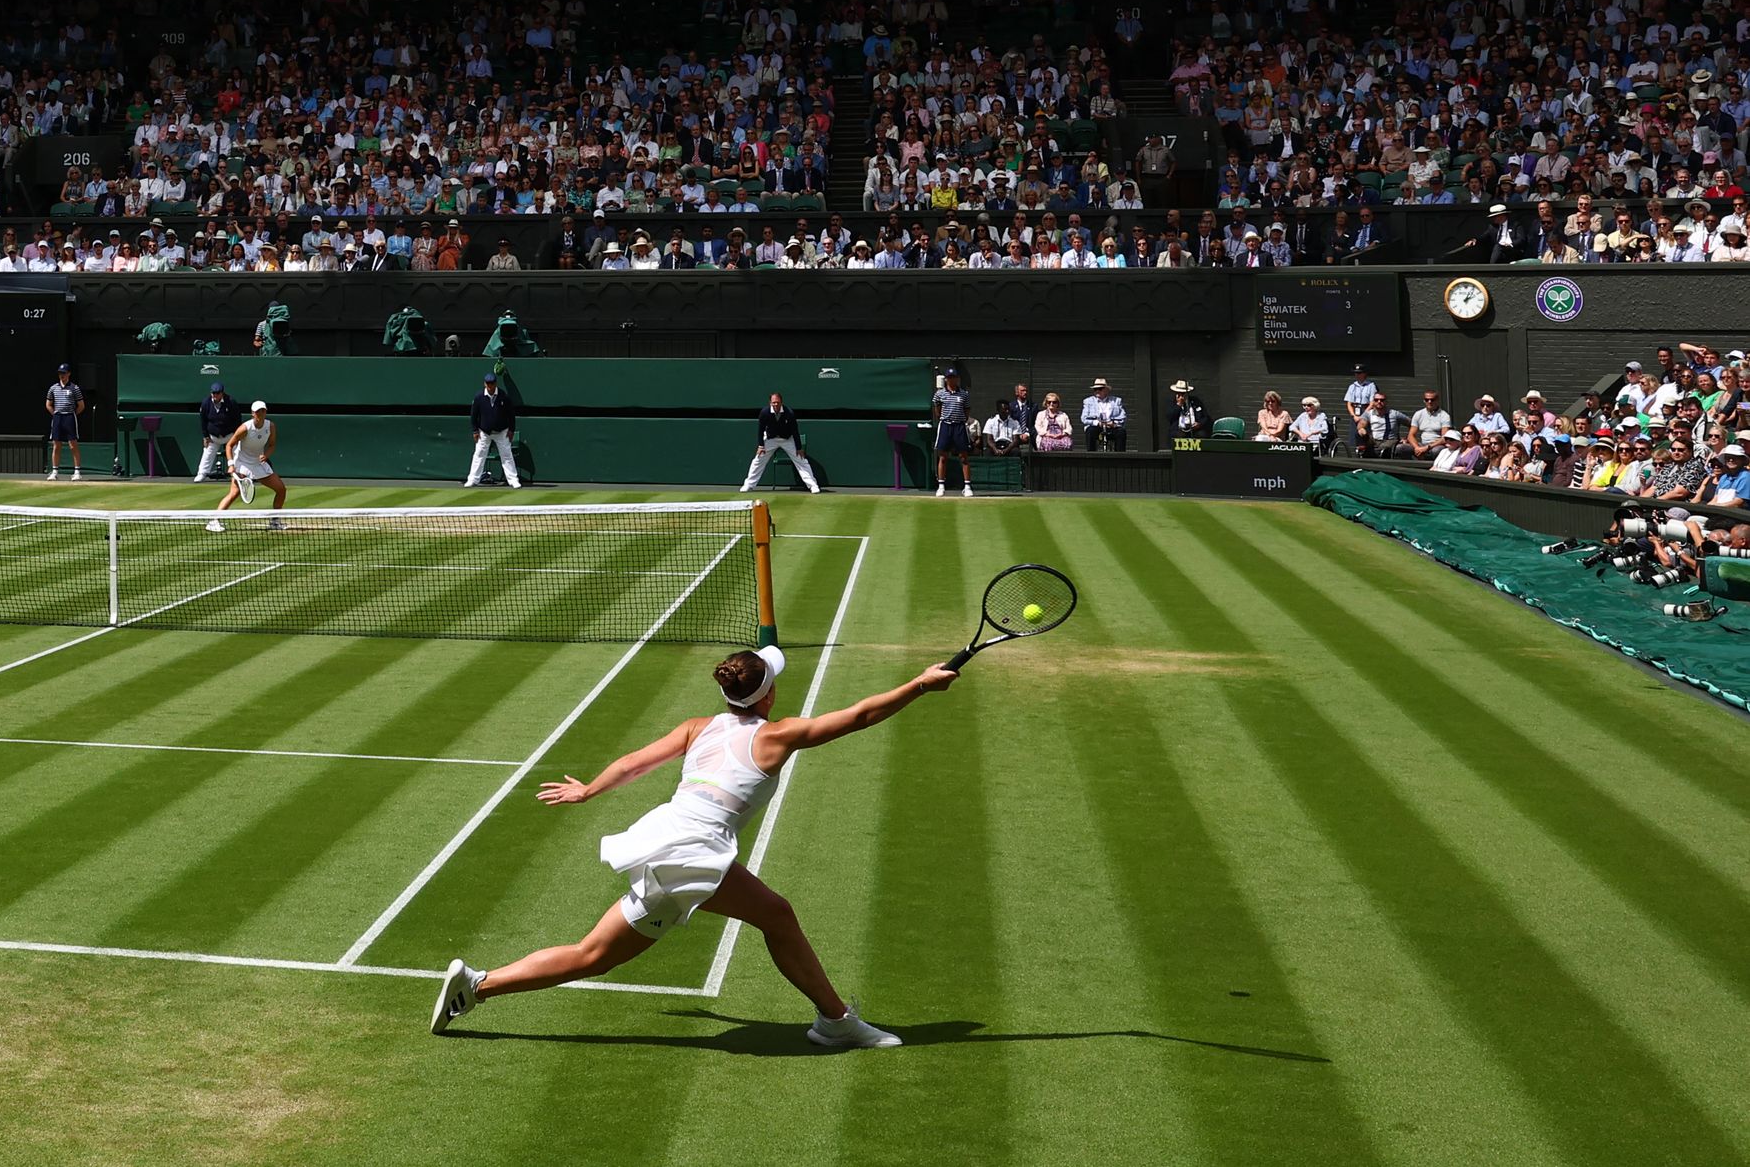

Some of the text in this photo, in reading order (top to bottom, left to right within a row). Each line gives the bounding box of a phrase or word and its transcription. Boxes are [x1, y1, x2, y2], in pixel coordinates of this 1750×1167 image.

[1115, 6, 1141, 19] 30
[63, 152, 91, 166] 206
[1262, 295, 1277, 305] Iga
[1345, 300, 1352, 309] 3
[23, 308, 46, 319] 0:27
[1263, 306, 1308, 314] SWIATEK
[1264, 320, 1288, 329] Elina
[1347, 326, 1353, 334] 2
[1264, 331, 1316, 339] SVITOLINA
[1173, 438, 1202, 451] IBM
[1268, 444, 1307, 452] JAGUAR
[1253, 476, 1286, 491] mph
